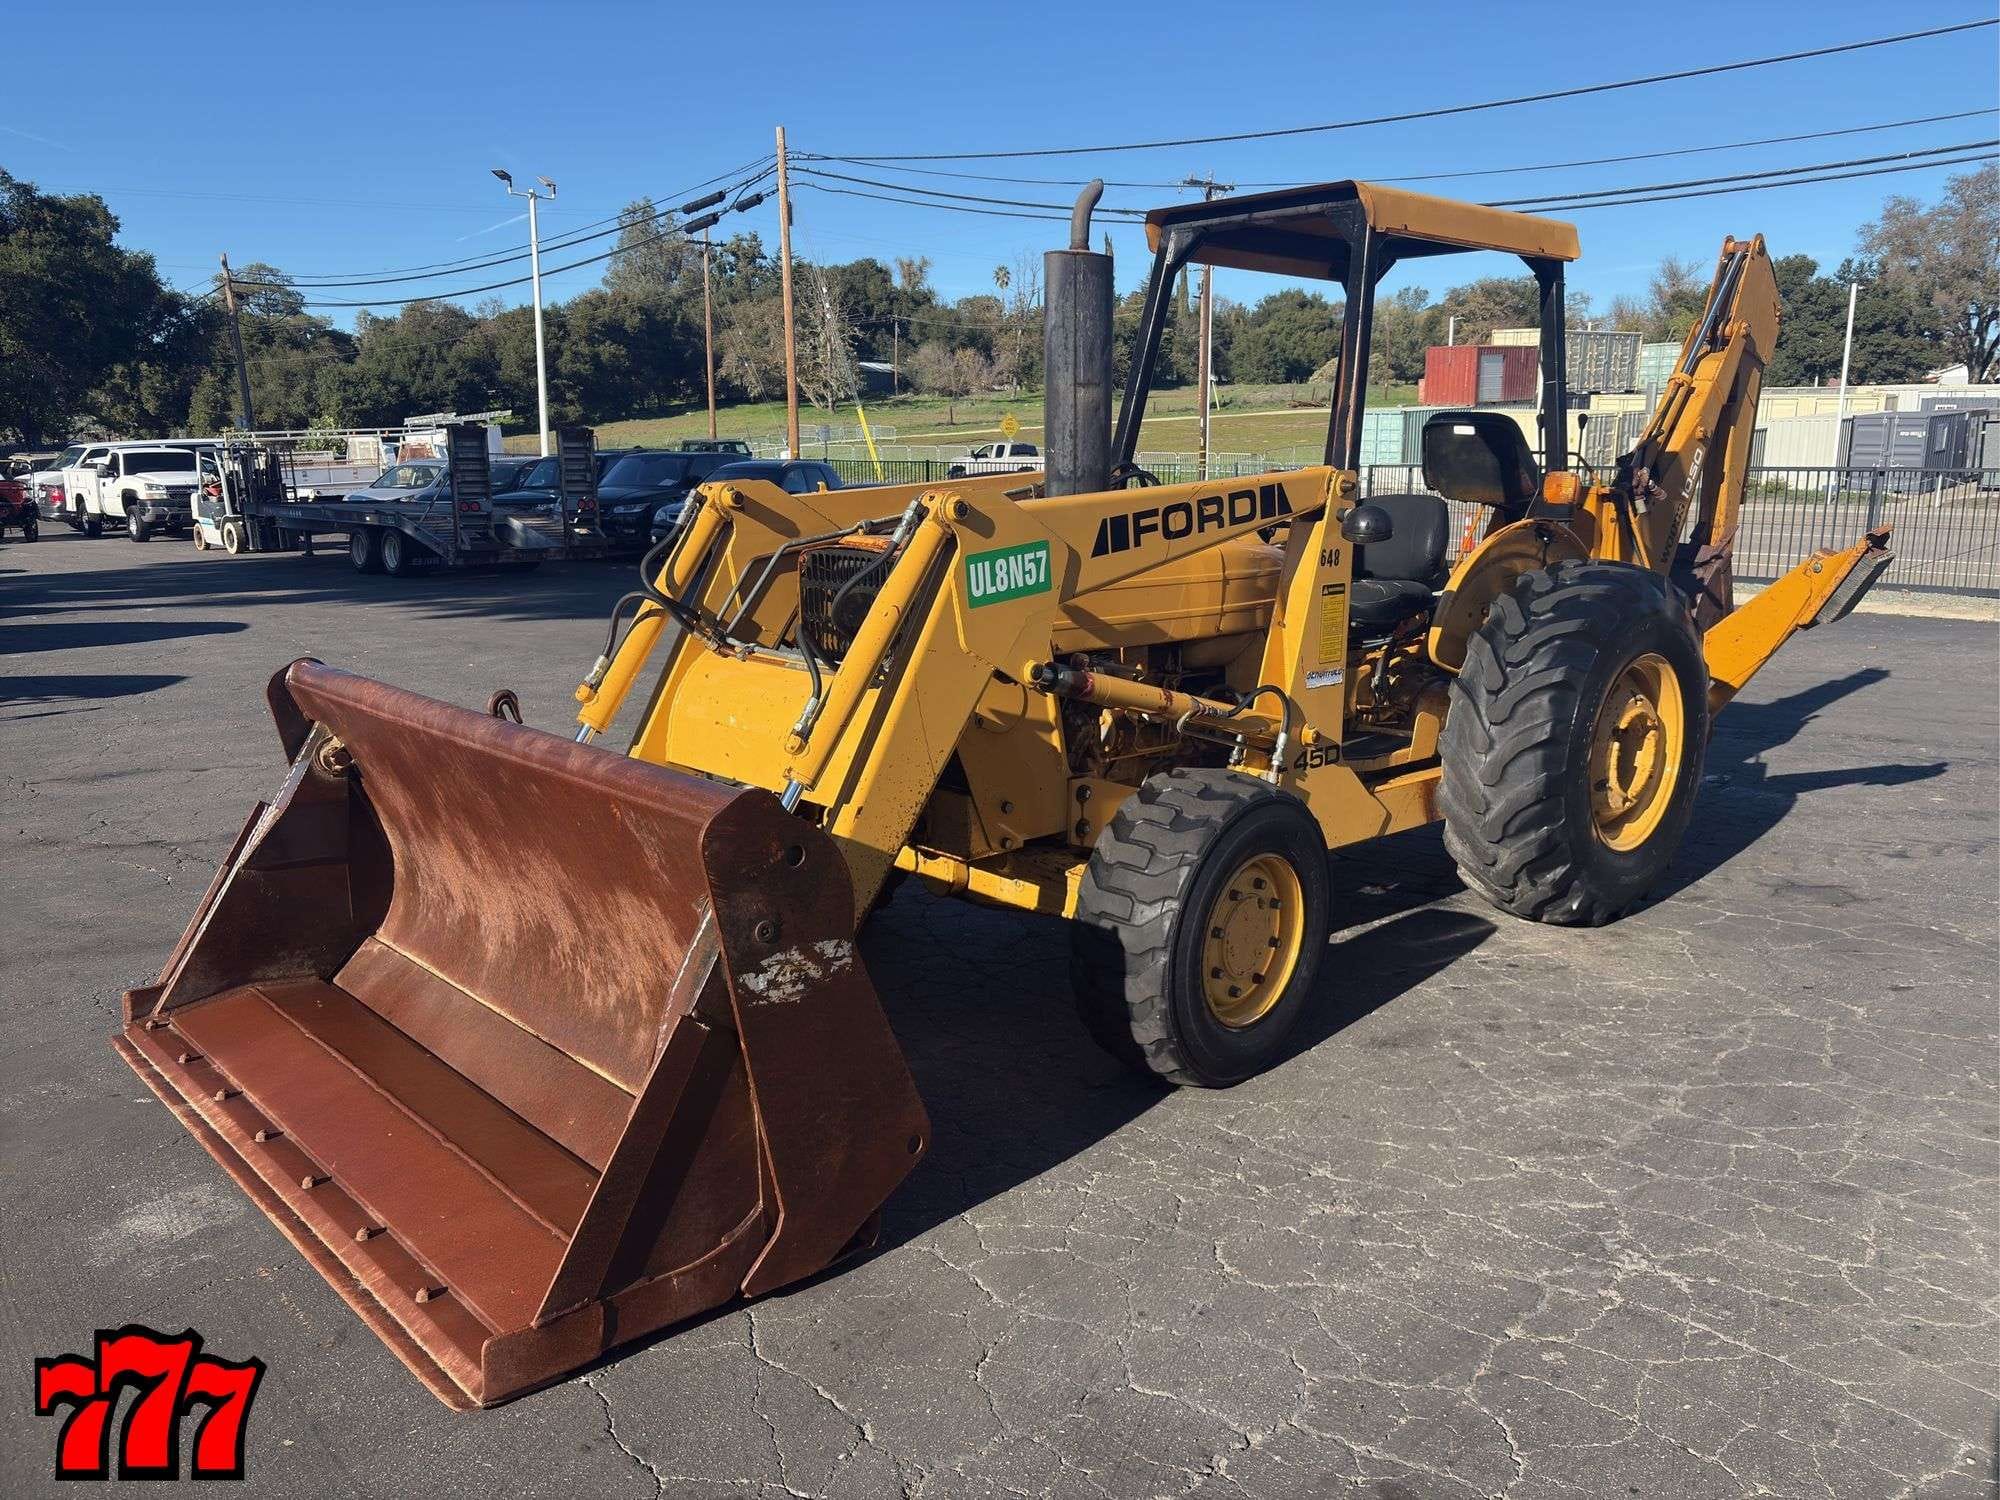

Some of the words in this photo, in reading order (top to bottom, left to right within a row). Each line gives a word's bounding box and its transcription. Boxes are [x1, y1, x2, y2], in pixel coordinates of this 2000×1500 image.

[1681, 447, 1703, 499] 1050
[1132, 489, 1257, 548] FORD
[969, 549, 1048, 598] UL8N57
[1320, 548, 1340, 567] 648
